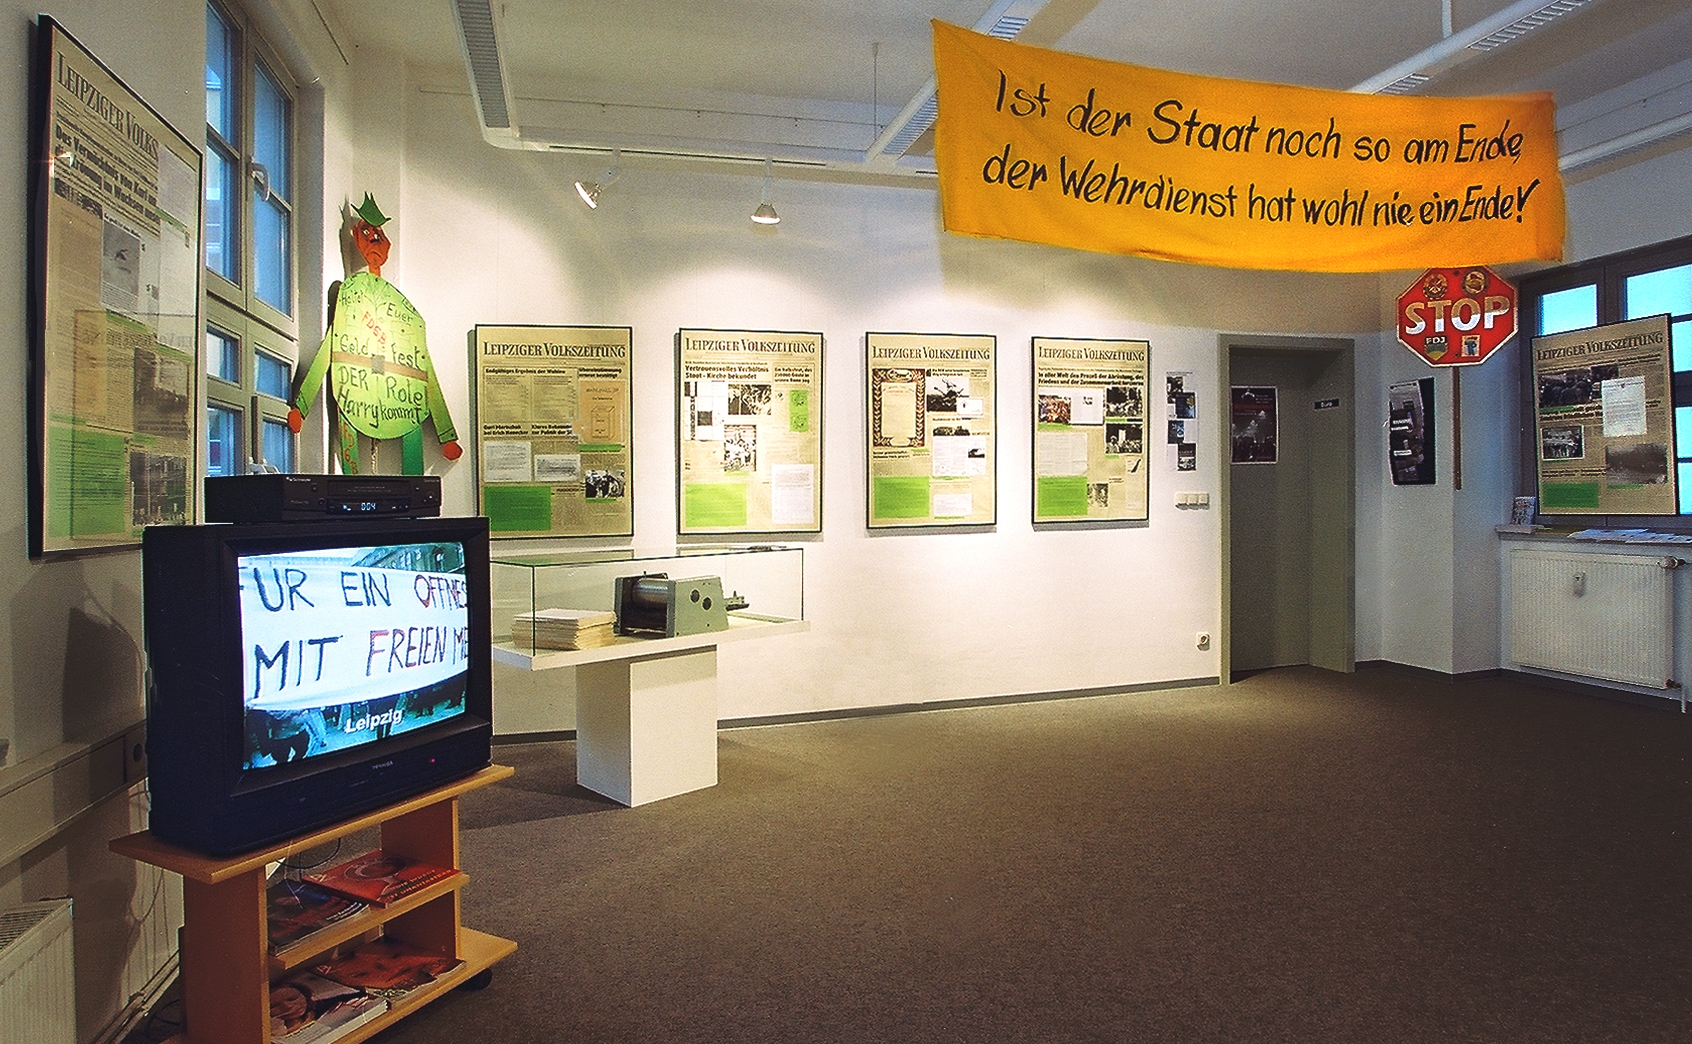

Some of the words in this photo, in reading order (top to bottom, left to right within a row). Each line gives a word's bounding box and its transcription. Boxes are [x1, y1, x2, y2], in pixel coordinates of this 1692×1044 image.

[58, 51, 124, 135] LEIPZIGER
[997, 70, 1050, 117] Ist
[1067, 88, 1131, 136] der
[1147, 100, 1260, 152] Staat
[1266, 117, 1346, 158] noch
[1354, 136, 1390, 162] so
[1404, 139, 1449, 164] am
[1455, 119, 1524, 164] Ende,
[982, 144, 1047, 190] der
[1060, 156, 1237, 217] Wehrdienst
[1249, 184, 1296, 221] hat
[1303, 189, 1368, 226] wohl
[1374, 192, 1415, 226] nie
[1420, 192, 1459, 224] ein
[1458, 179, 1541, 223] Ende!
[1405, 295, 1510, 335] STOP
[484, 341, 542, 356] LEIPZIGER
[543, 342, 625, 358] VOLKSZEITUNG
[686, 337, 739, 351] LEIPZIGER
[741, 339, 815, 353] VOLKSZEITUNG
[872, 346, 921, 359] LEIPZIGER
[923, 346, 990, 360] VOLKSZEITUNG
[1039, 347, 1082, 359] LEIPZIGER
[1084, 348, 1144, 361] VOLKSZEITUNG
[1537, 345, 1585, 360] LEIPZIGER
[1585, 332, 1663, 353] VOLKSZEITUNG
[338, 365, 369, 391] DER
[337, 386, 379, 428] Harry
[341, 572, 391, 607] EIN
[254, 635, 343, 699] MIT
[366, 626, 447, 677] FREIEN
[345, 709, 402, 734] Leipzig
